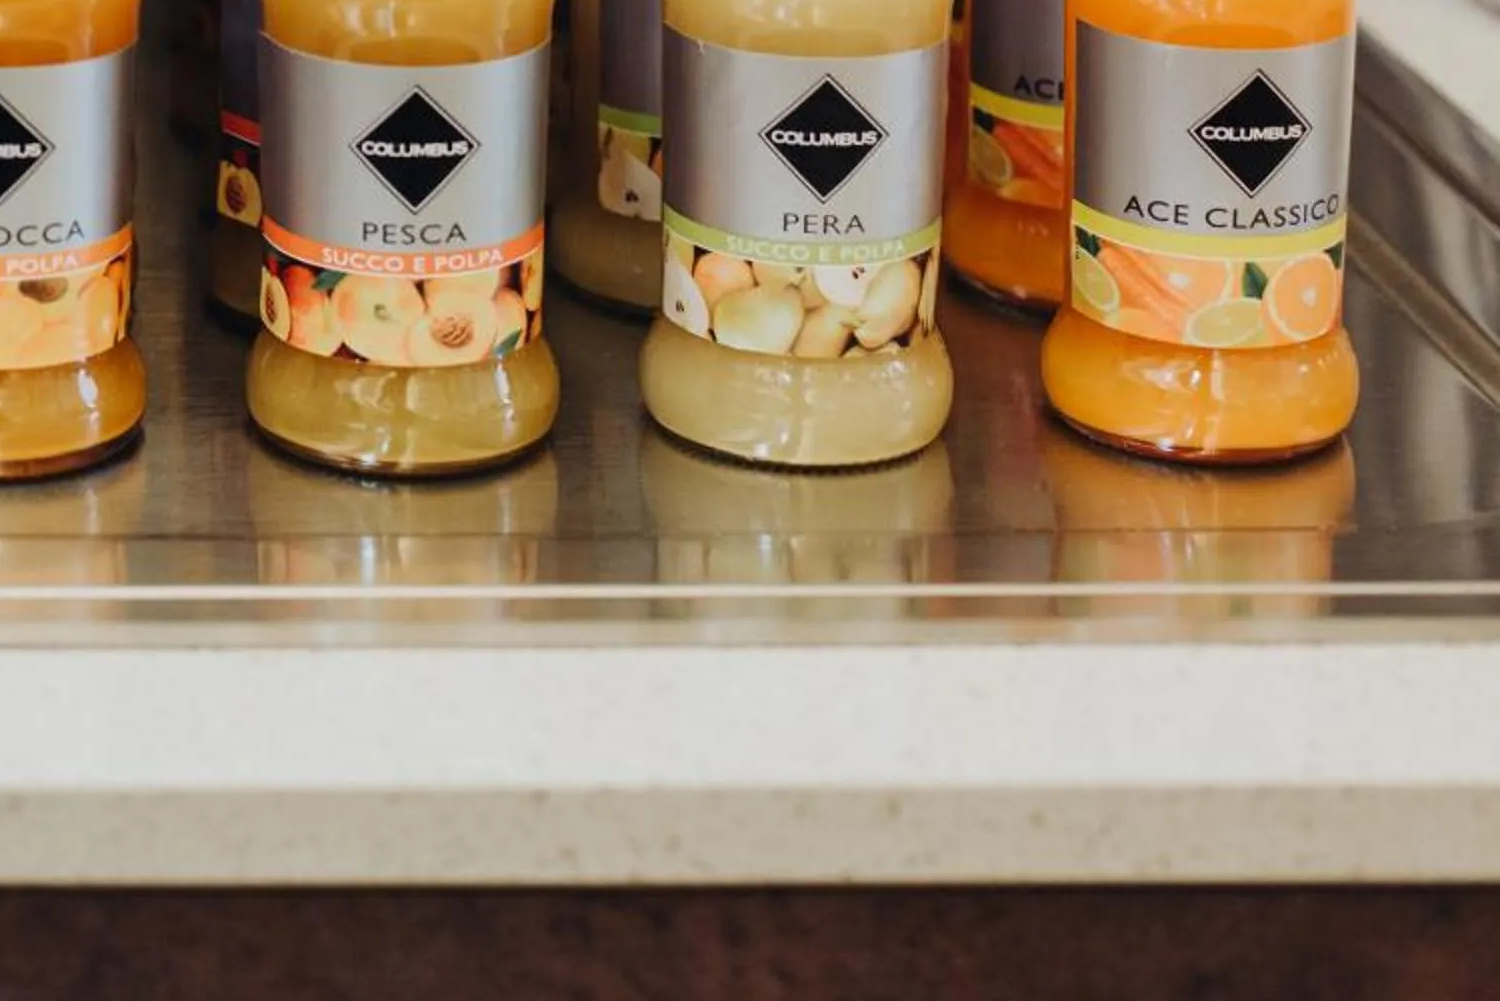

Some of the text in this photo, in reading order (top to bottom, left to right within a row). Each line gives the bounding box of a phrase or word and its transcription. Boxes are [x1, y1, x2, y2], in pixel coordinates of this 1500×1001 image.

[771, 130, 877, 147] COLUMBUS
[1201, 124, 1302, 142] COLUMBUS
[361, 140, 470, 159] COLUMBUS
[1123, 194, 1340, 230] ACE CLASSICO
[362, 222, 467, 245] PESCA
[782, 213, 866, 235] PERA
[322, 247, 505, 271] SUCCO E POLPA
[726, 234, 810, 262] SUCCO
[819, 246, 831, 262] E
[7, 251, 79, 274] POLPA
